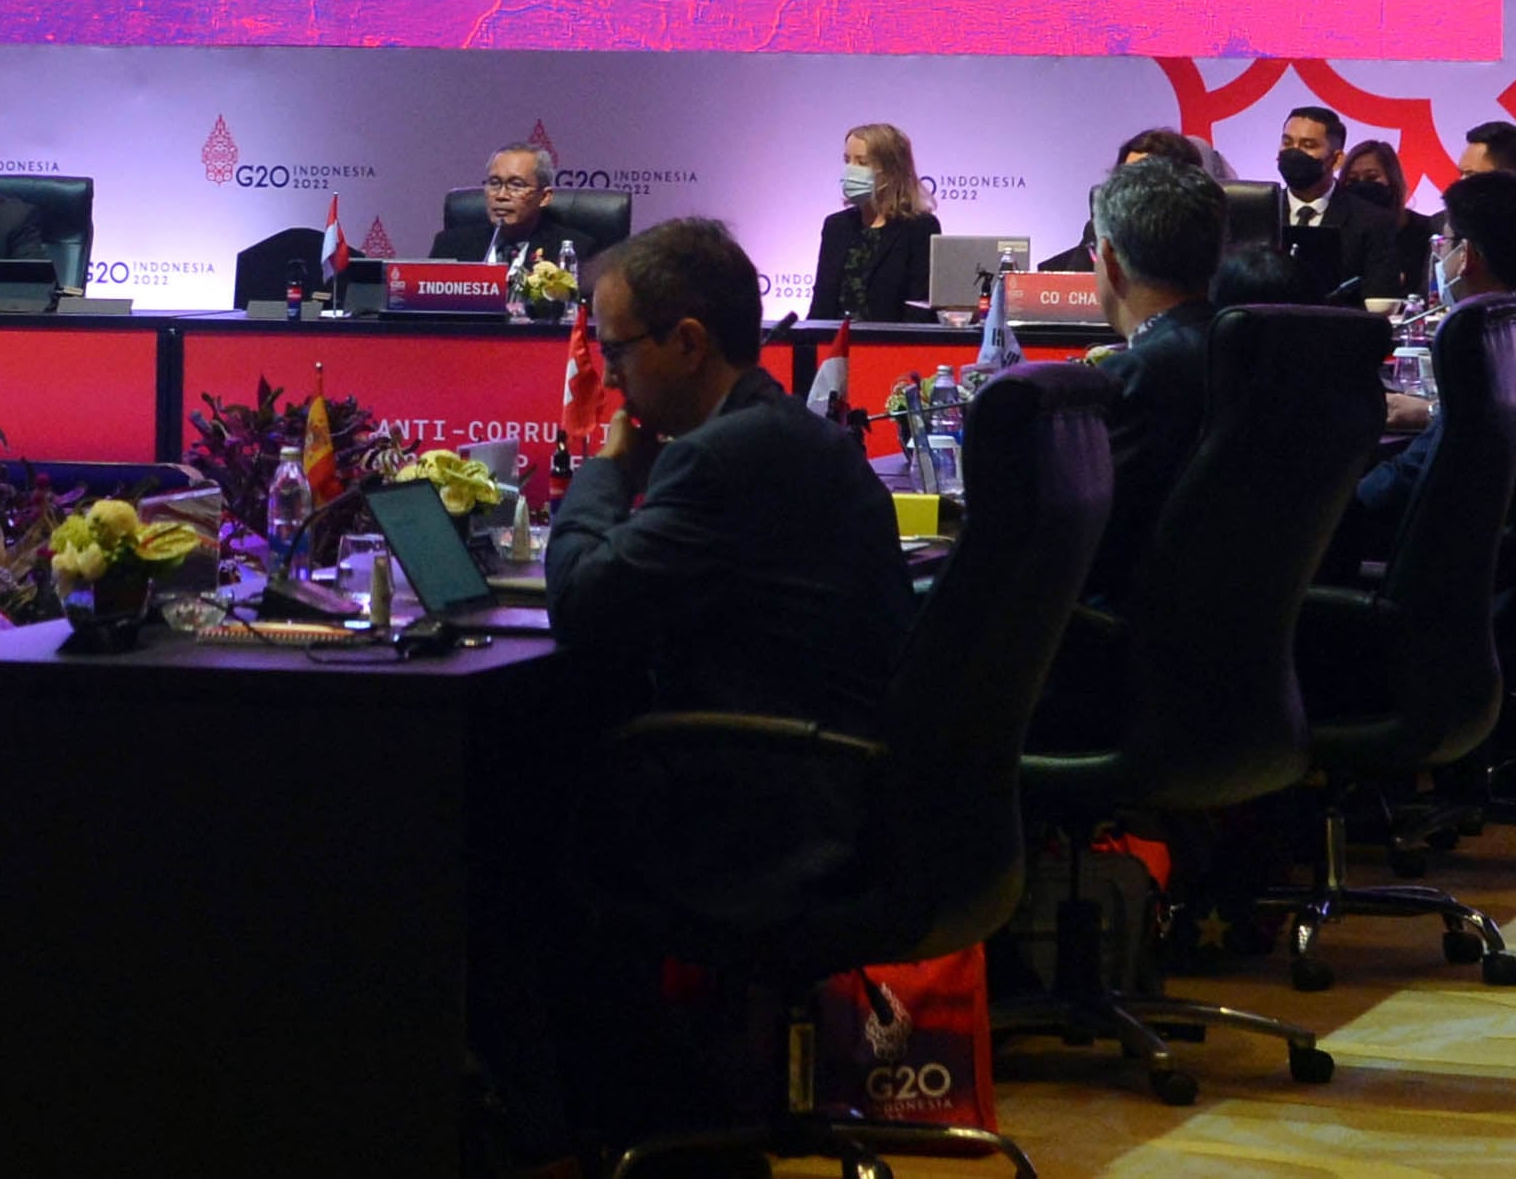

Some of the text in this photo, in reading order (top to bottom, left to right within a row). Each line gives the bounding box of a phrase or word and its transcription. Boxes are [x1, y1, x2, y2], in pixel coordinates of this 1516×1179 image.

[235, 164, 376, 188] G20 INDONESIA
[614, 171, 698, 182] INDONESIA
[941, 176, 1026, 188] INDONESIA
[293, 179, 330, 189] 2022
[941, 189, 978, 200] 2022
[133, 261, 215, 273] INDONESIA
[134, 275, 169, 285] 2022
[418, 281, 500, 295] INDONESIA
[775, 287, 811, 298] 2022
[1040, 291, 1060, 304] CO
[1068, 292, 1101, 306] CHA
[868, 1063, 951, 1099] G20
